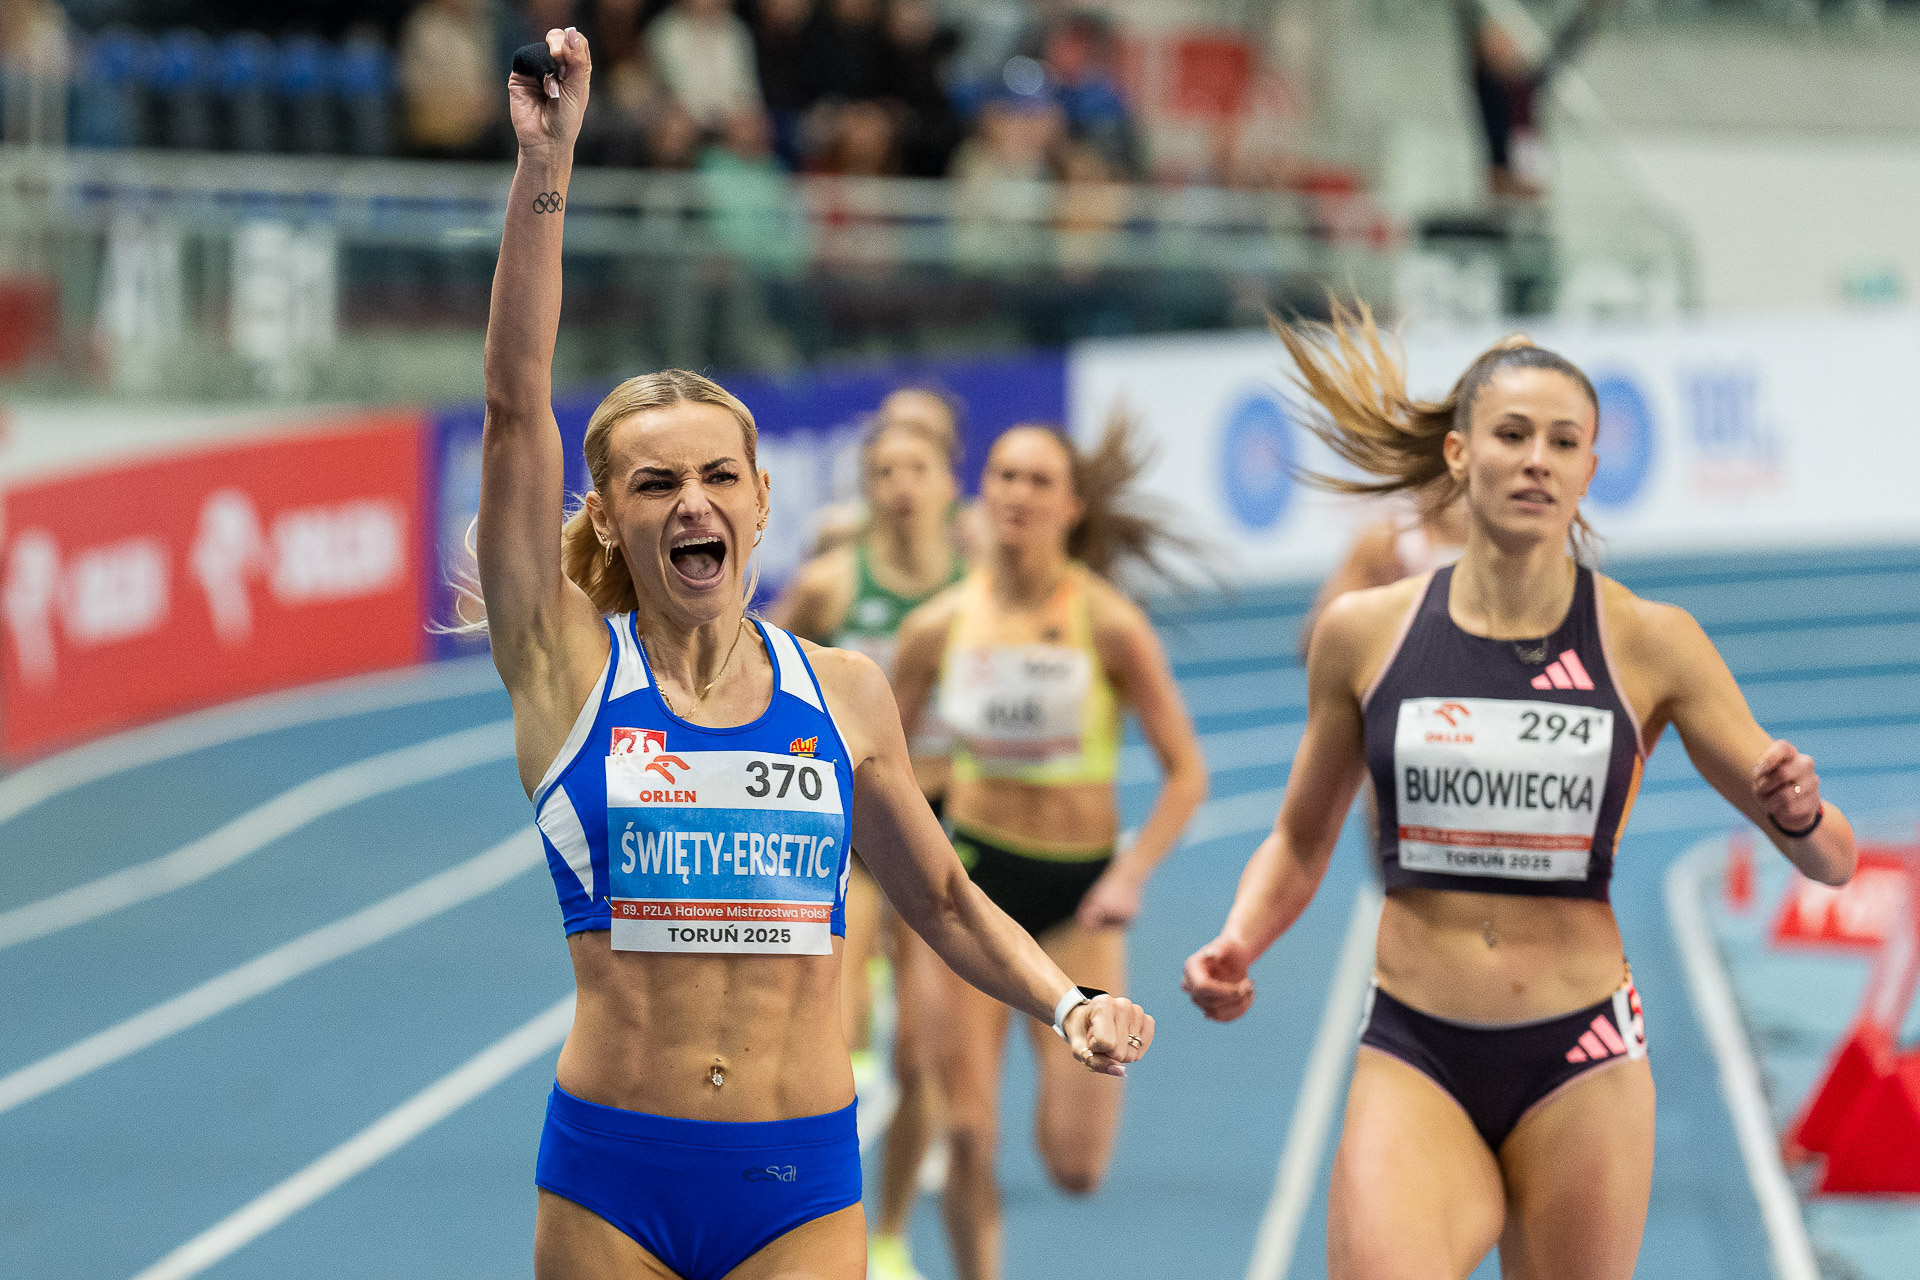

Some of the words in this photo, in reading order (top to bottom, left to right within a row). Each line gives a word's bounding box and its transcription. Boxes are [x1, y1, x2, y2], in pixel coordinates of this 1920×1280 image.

[1519, 711, 1591, 744] 294
[790, 736, 818, 752] AWF
[745, 761, 822, 801] 370
[1405, 766, 1593, 812] BUKOWIECKA
[640, 790, 696, 802] ORLEN
[621, 822, 835, 884] ŚWIĘTY-ERSETIC
[622, 904, 640, 916] 69.
[643, 905, 671, 916] PZLA
[675, 906, 723, 917] Halowe
[727, 905, 798, 918] Mistrzostwa
[668, 924, 738, 943] TORUŃ
[743, 928, 791, 943] 2025
